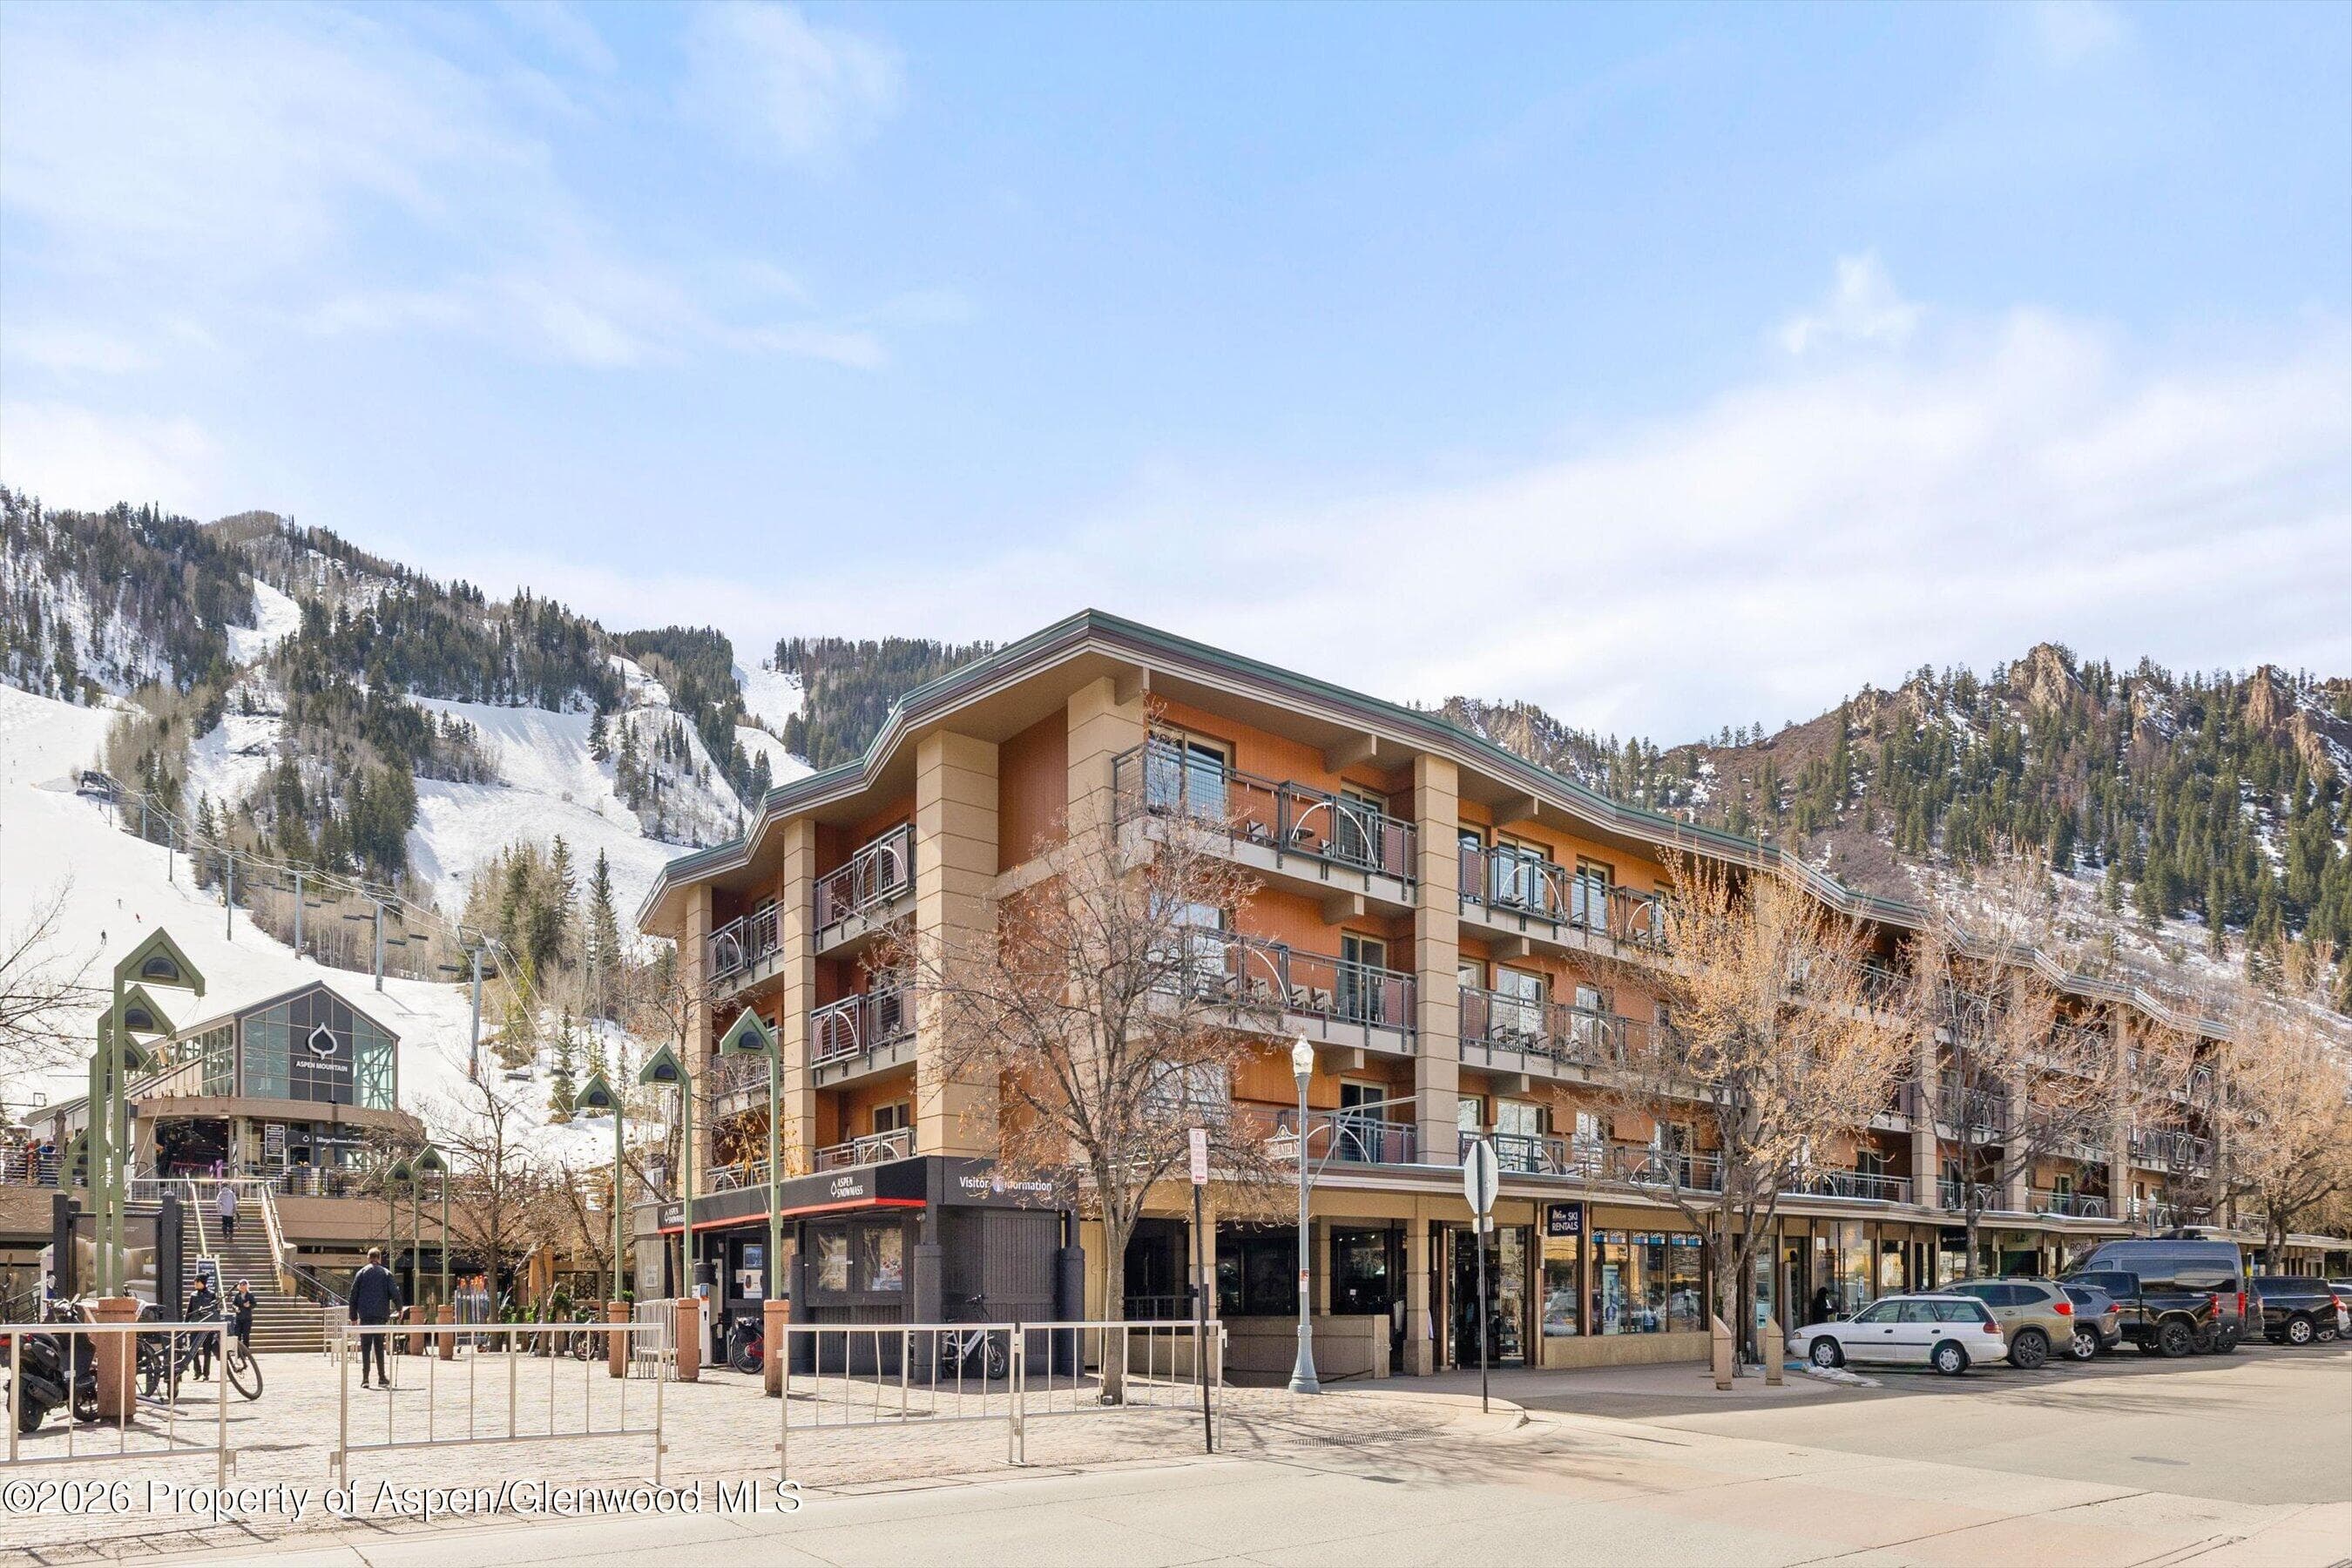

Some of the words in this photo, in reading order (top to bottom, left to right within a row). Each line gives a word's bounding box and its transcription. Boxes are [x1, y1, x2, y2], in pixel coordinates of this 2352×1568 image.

[316, 1063, 348, 1072] MOUNTAIN
[837, 1176, 853, 1187] ASPEN
[959, 1176, 989, 1188] Visitor
[836, 1185, 863, 1198] SNOWMASS
[1568, 1211, 1578, 1220] SKI
[1551, 1221, 1578, 1232] RENTALS
